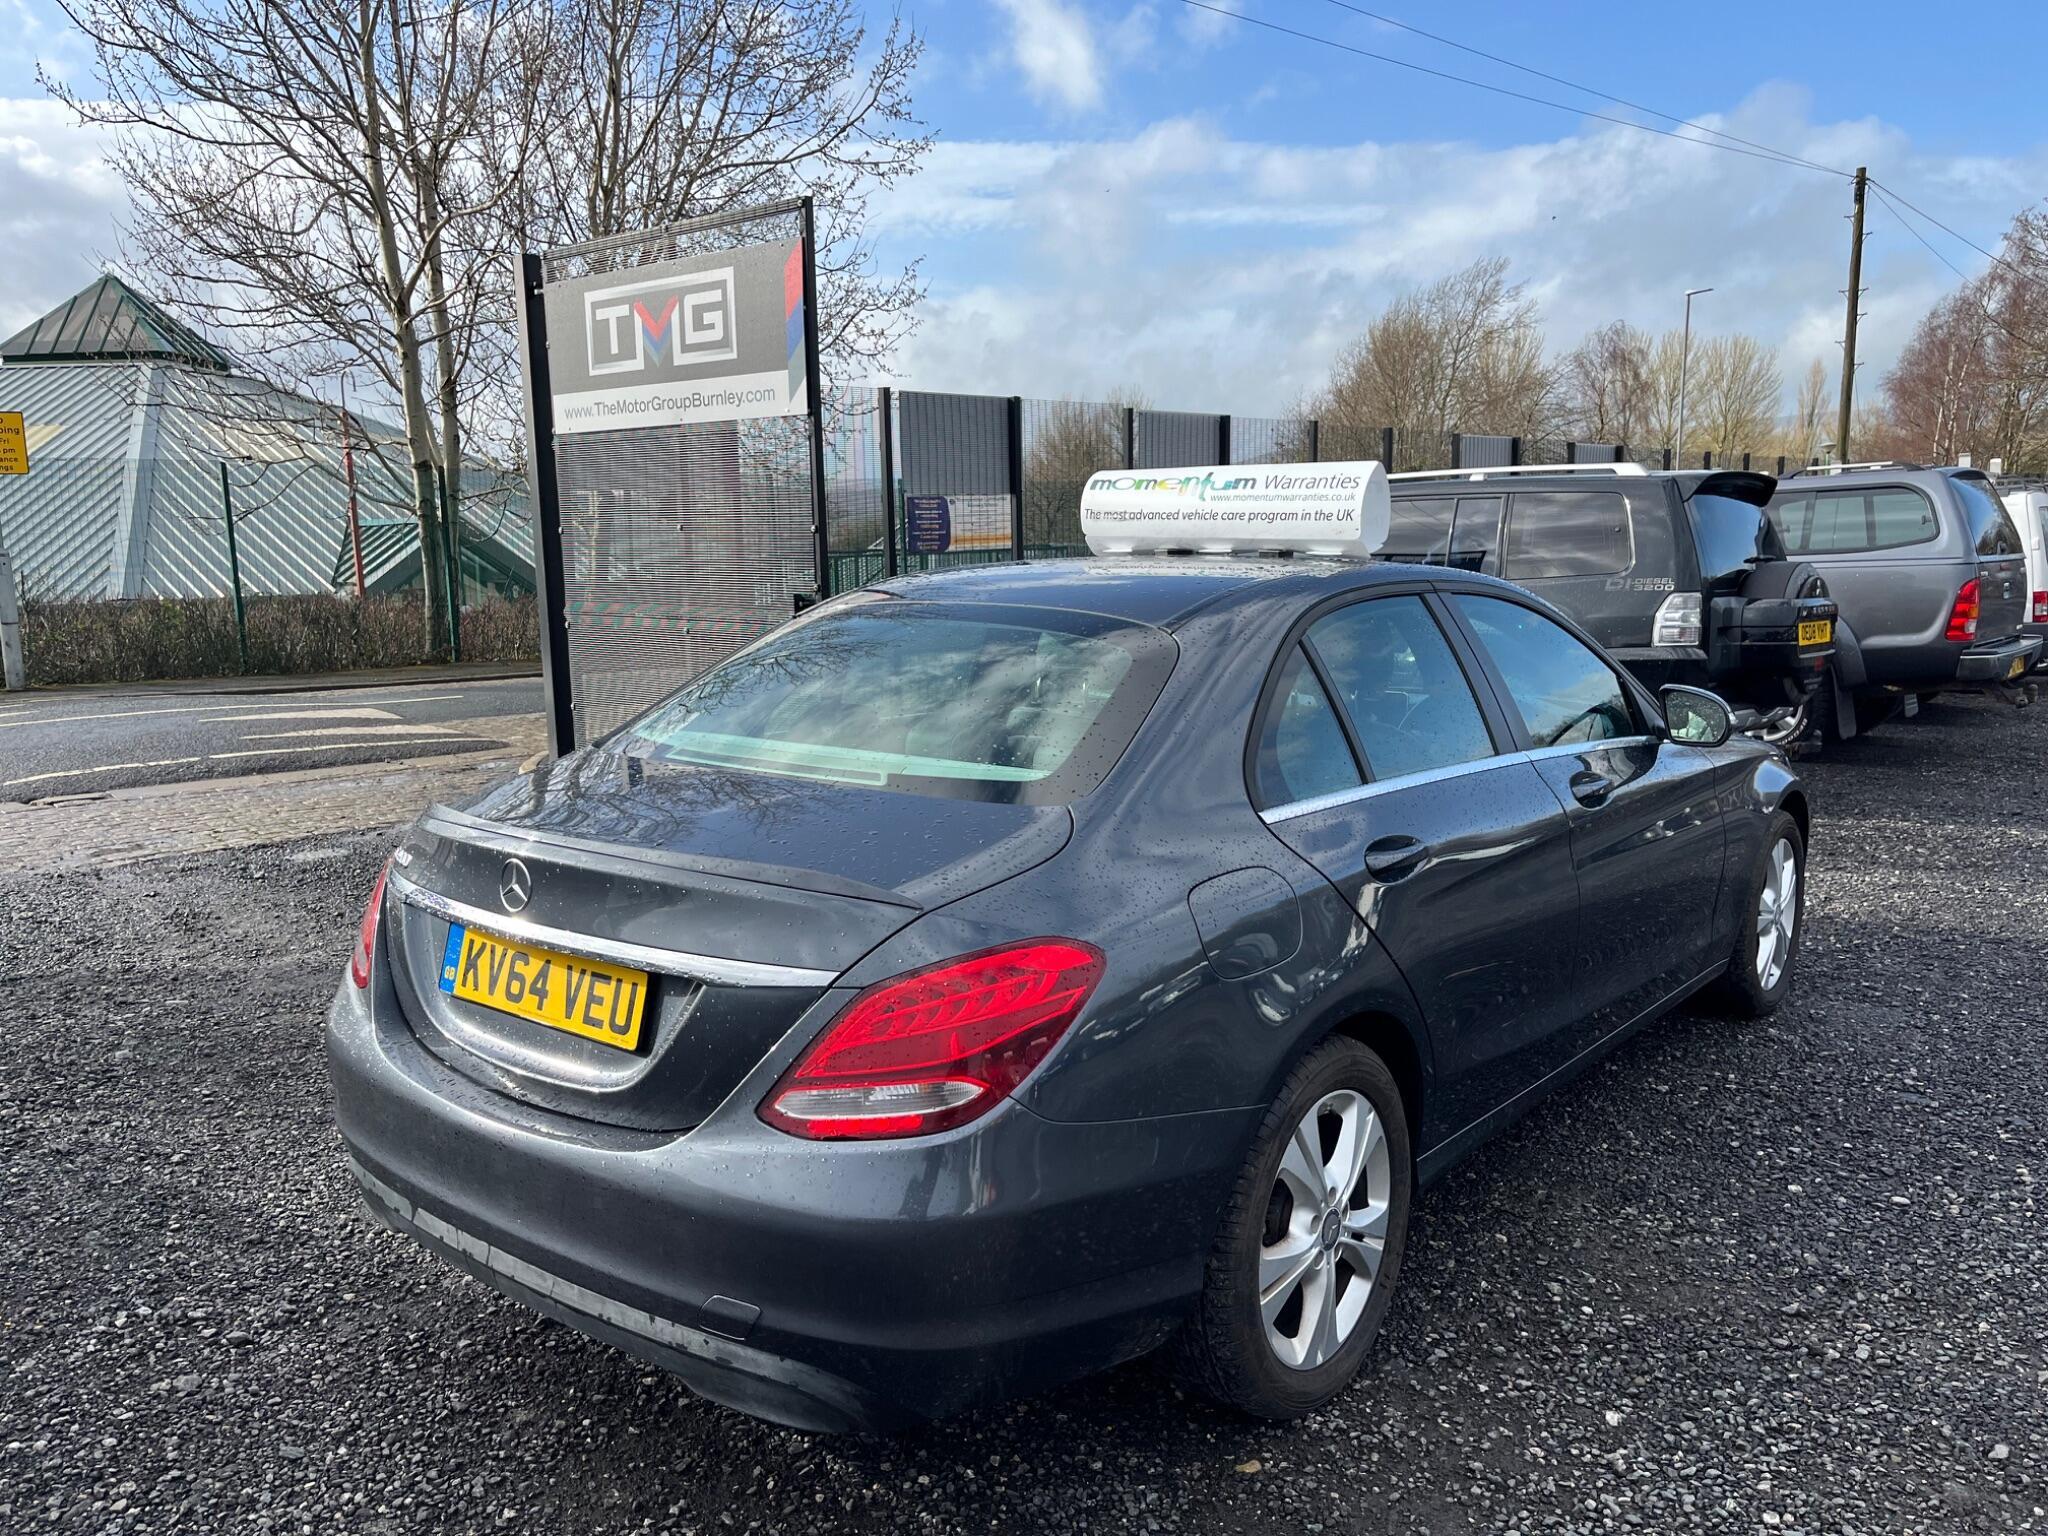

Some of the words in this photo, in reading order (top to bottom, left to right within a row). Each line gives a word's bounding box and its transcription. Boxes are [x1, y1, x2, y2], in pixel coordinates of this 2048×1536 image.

[594, 287, 726, 368] TMG
[564, 387, 776, 419] www.TheMotorGroupBurnley.com
[1089, 472, 1257, 501] momentum
[1265, 474, 1361, 490] Warranties
[1210, 492, 1356, 502] www.momentumwarranties.co.uk
[1085, 509, 1101, 521] The
[1103, 510, 1128, 521] most
[1129, 509, 1180, 521] advanced
[1181, 509, 1219, 521] vehicle
[1220, 512, 1246, 521] care
[1248, 511, 1299, 524] program
[1300, 509, 1312, 521] in
[1314, 509, 1335, 521] the
[1336, 509, 1356, 521] UK
[461, 938, 552, 1011] KV64
[565, 964, 639, 1036] VEU
